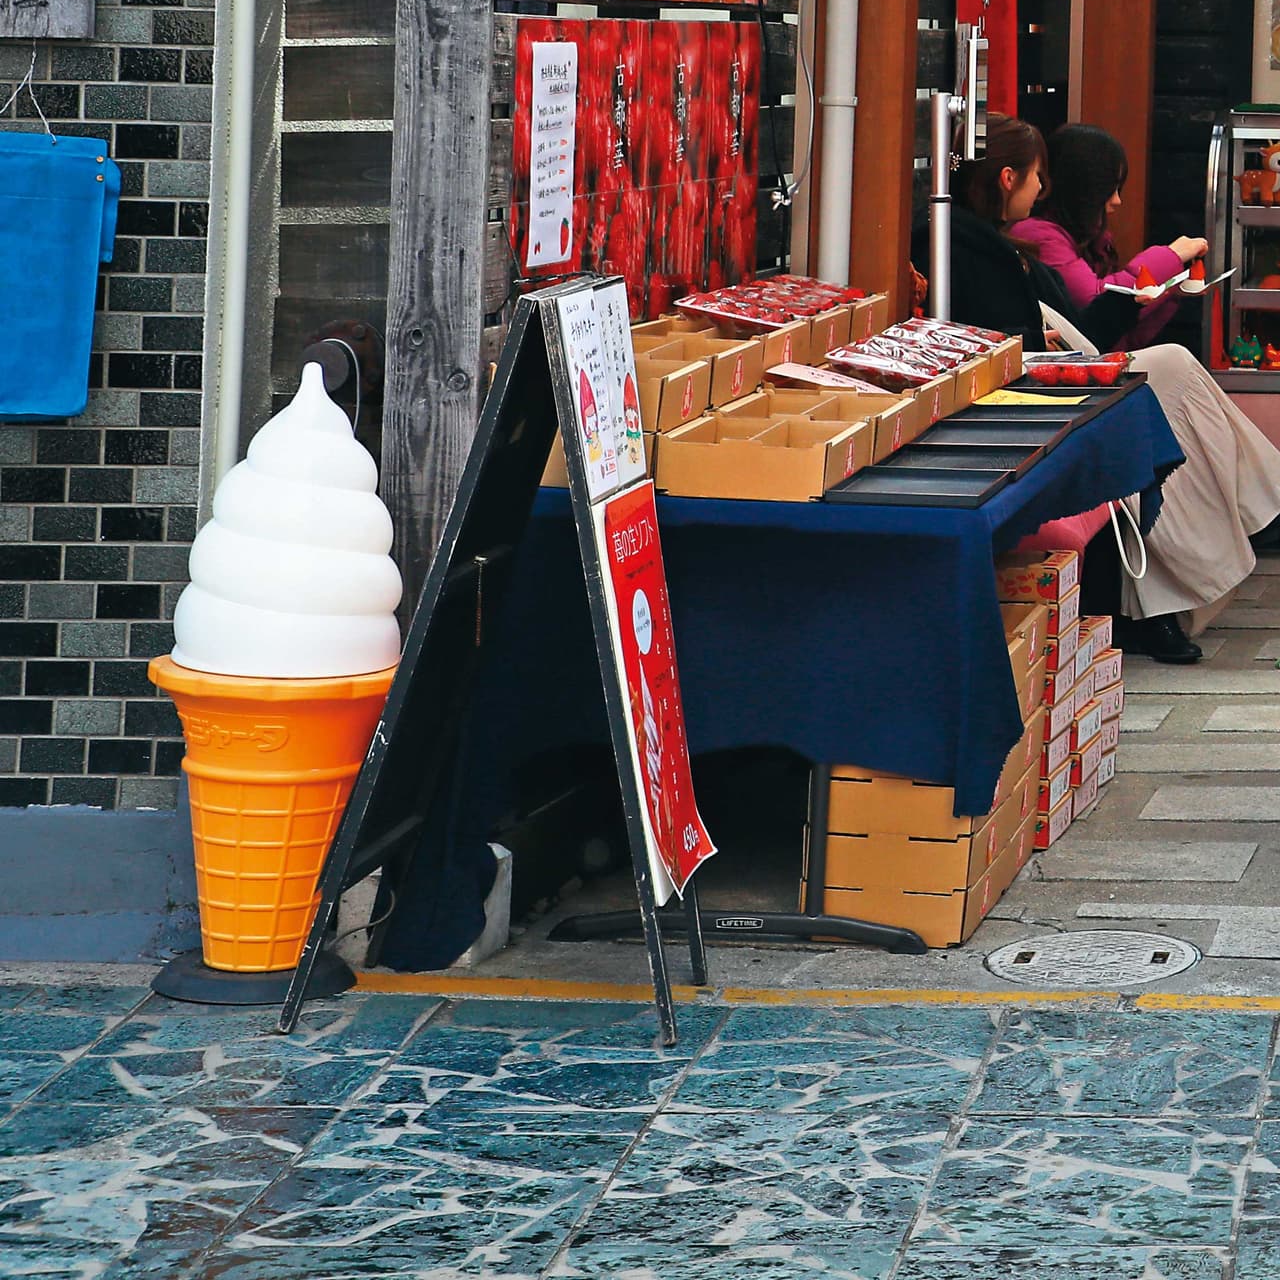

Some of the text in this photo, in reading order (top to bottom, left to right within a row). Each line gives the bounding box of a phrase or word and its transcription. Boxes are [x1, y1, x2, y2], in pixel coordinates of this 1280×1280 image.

[612, 517, 655, 563] 苺の生ソフト
